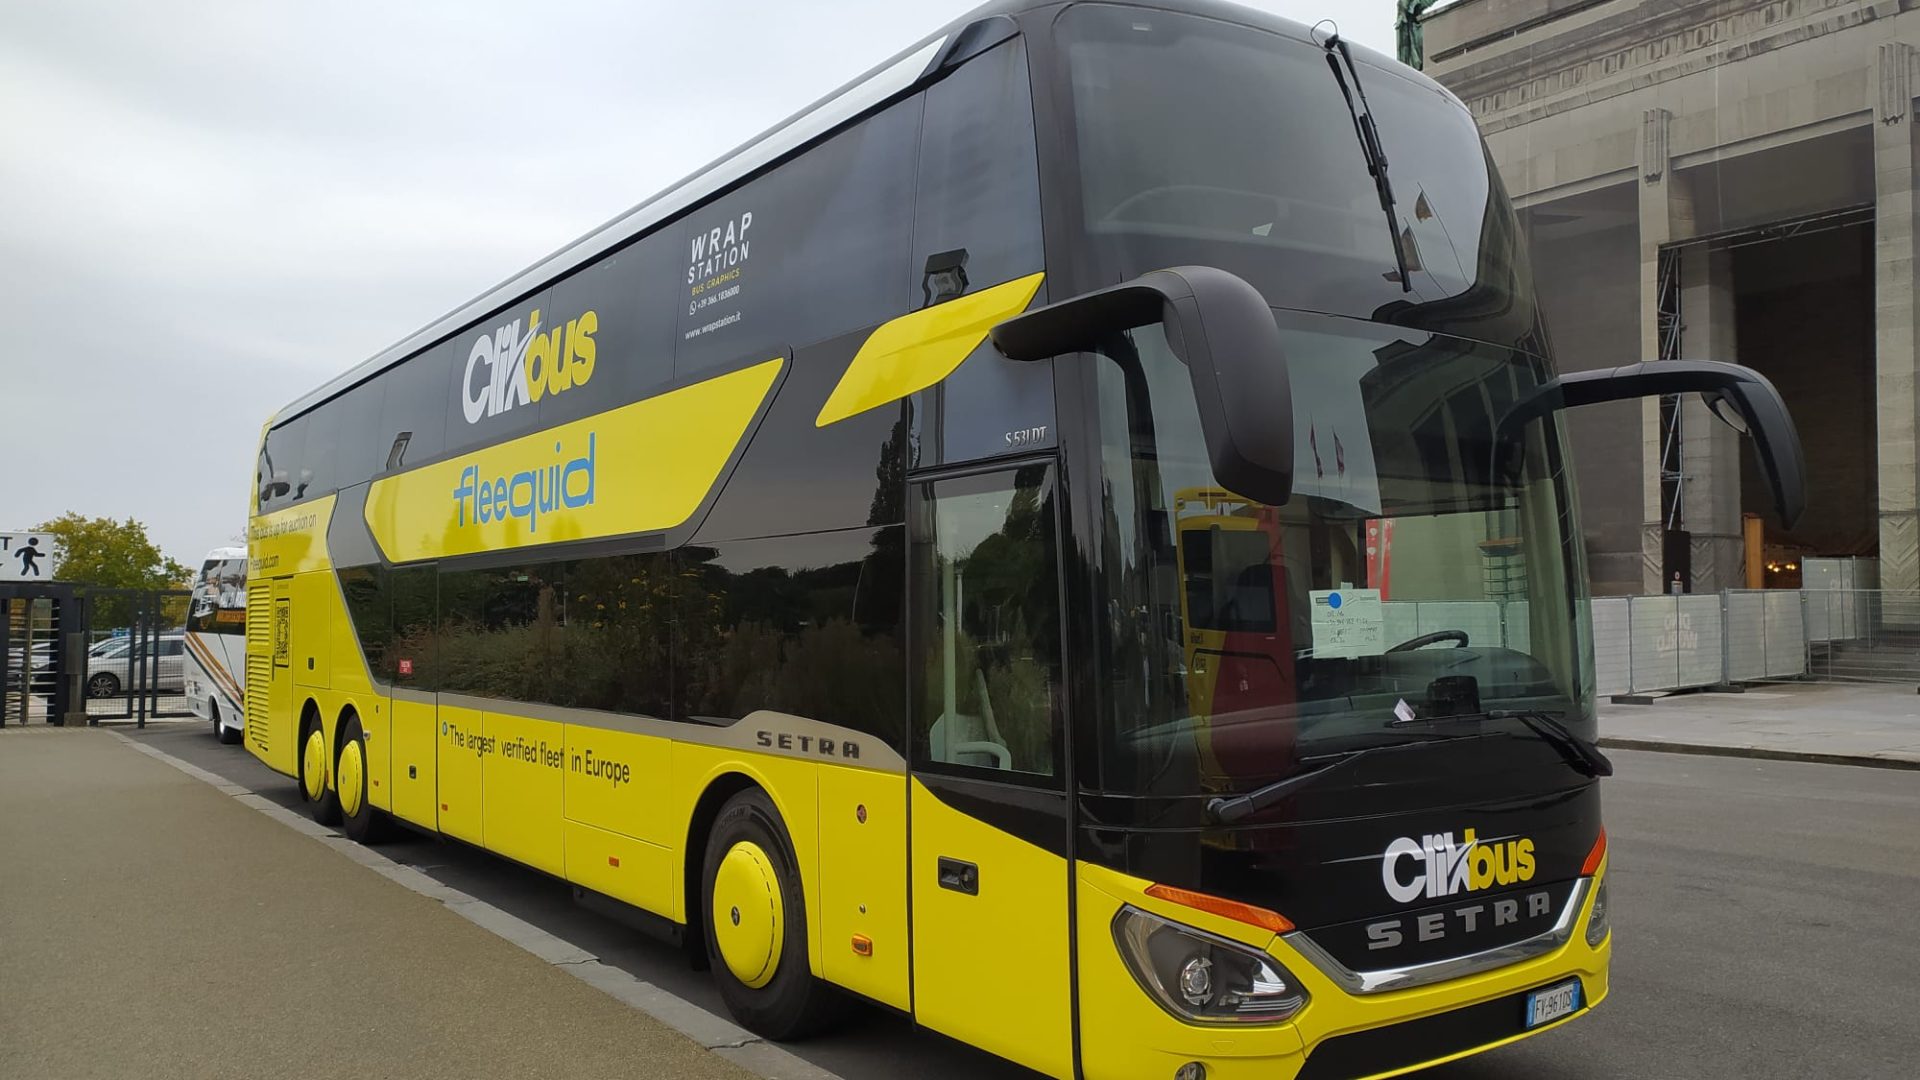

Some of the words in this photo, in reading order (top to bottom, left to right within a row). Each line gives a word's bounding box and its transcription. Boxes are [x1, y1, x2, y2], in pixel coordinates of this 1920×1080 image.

[692, 211, 753, 263] WRAP
[688, 240, 750, 284] STATION
[692, 283, 705, 296] BUS
[707, 267, 740, 289] GRAPHICS
[1005, 432, 1012, 446] S
[1014, 428, 1030, 446] 531
[1032, 426, 1047, 444] DT
[453, 432, 595, 533] fleequid
[288, 516, 308, 532] auction
[308, 514, 317, 529] on
[449, 724, 464, 748] The
[466, 727, 496, 758] largest
[501, 736, 537, 764] verified
[540, 740, 564, 769] fleet
[571, 746, 582, 773] in
[585, 749, 630, 788] Europe
[757, 730, 860, 759] SETRA
[1366, 892, 1550, 950] SETRA
